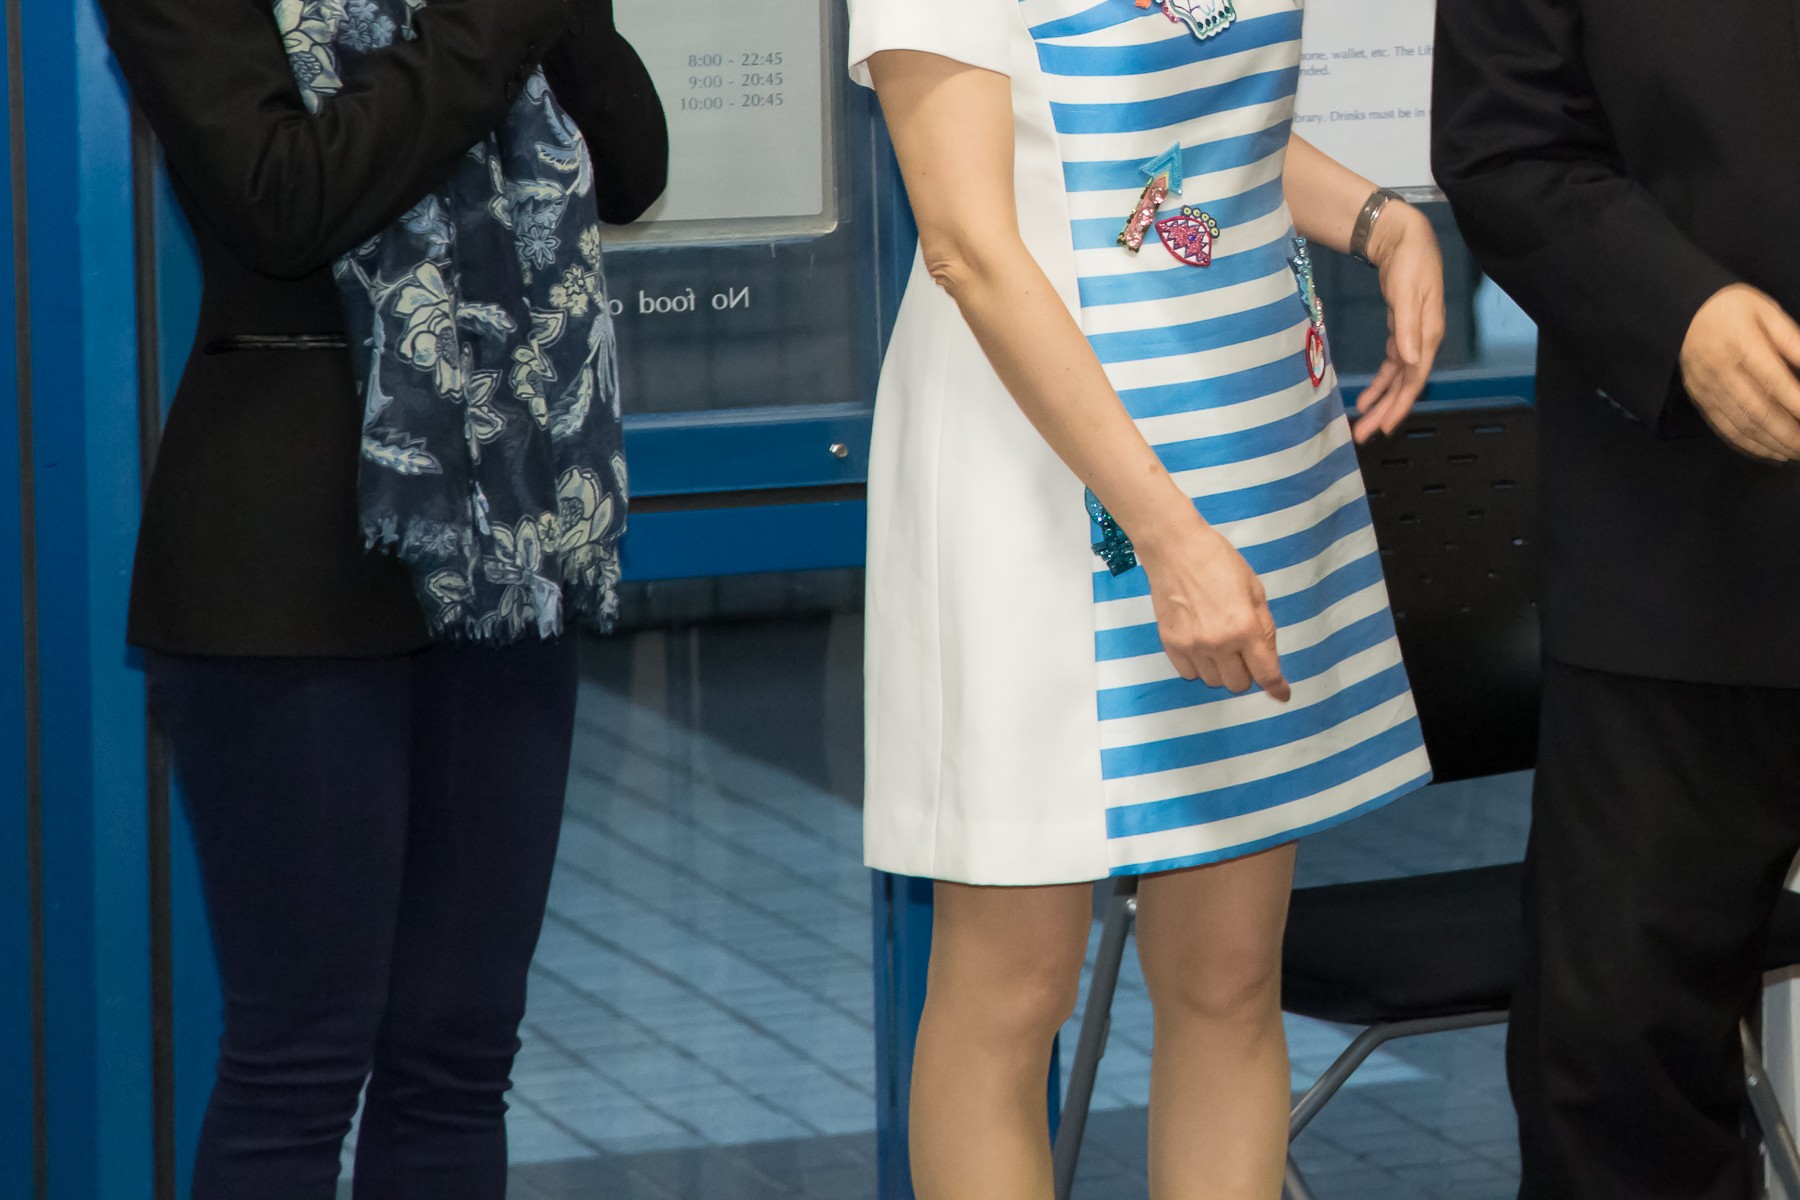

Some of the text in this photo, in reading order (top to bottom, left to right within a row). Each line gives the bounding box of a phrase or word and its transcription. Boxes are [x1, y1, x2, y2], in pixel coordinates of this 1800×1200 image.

[1394, 46, 1414, 56] The
[688, 52, 784, 67] 8:00 22:45
[688, 73, 784, 89] 9:00 20:45
[679, 93, 784, 111] 10:00 20:45
[1330, 109, 1366, 122] Drinks
[1369, 109, 1395, 120] must
[1398, 106, 1412, 118] be
[1415, 106, 1425, 118] in
